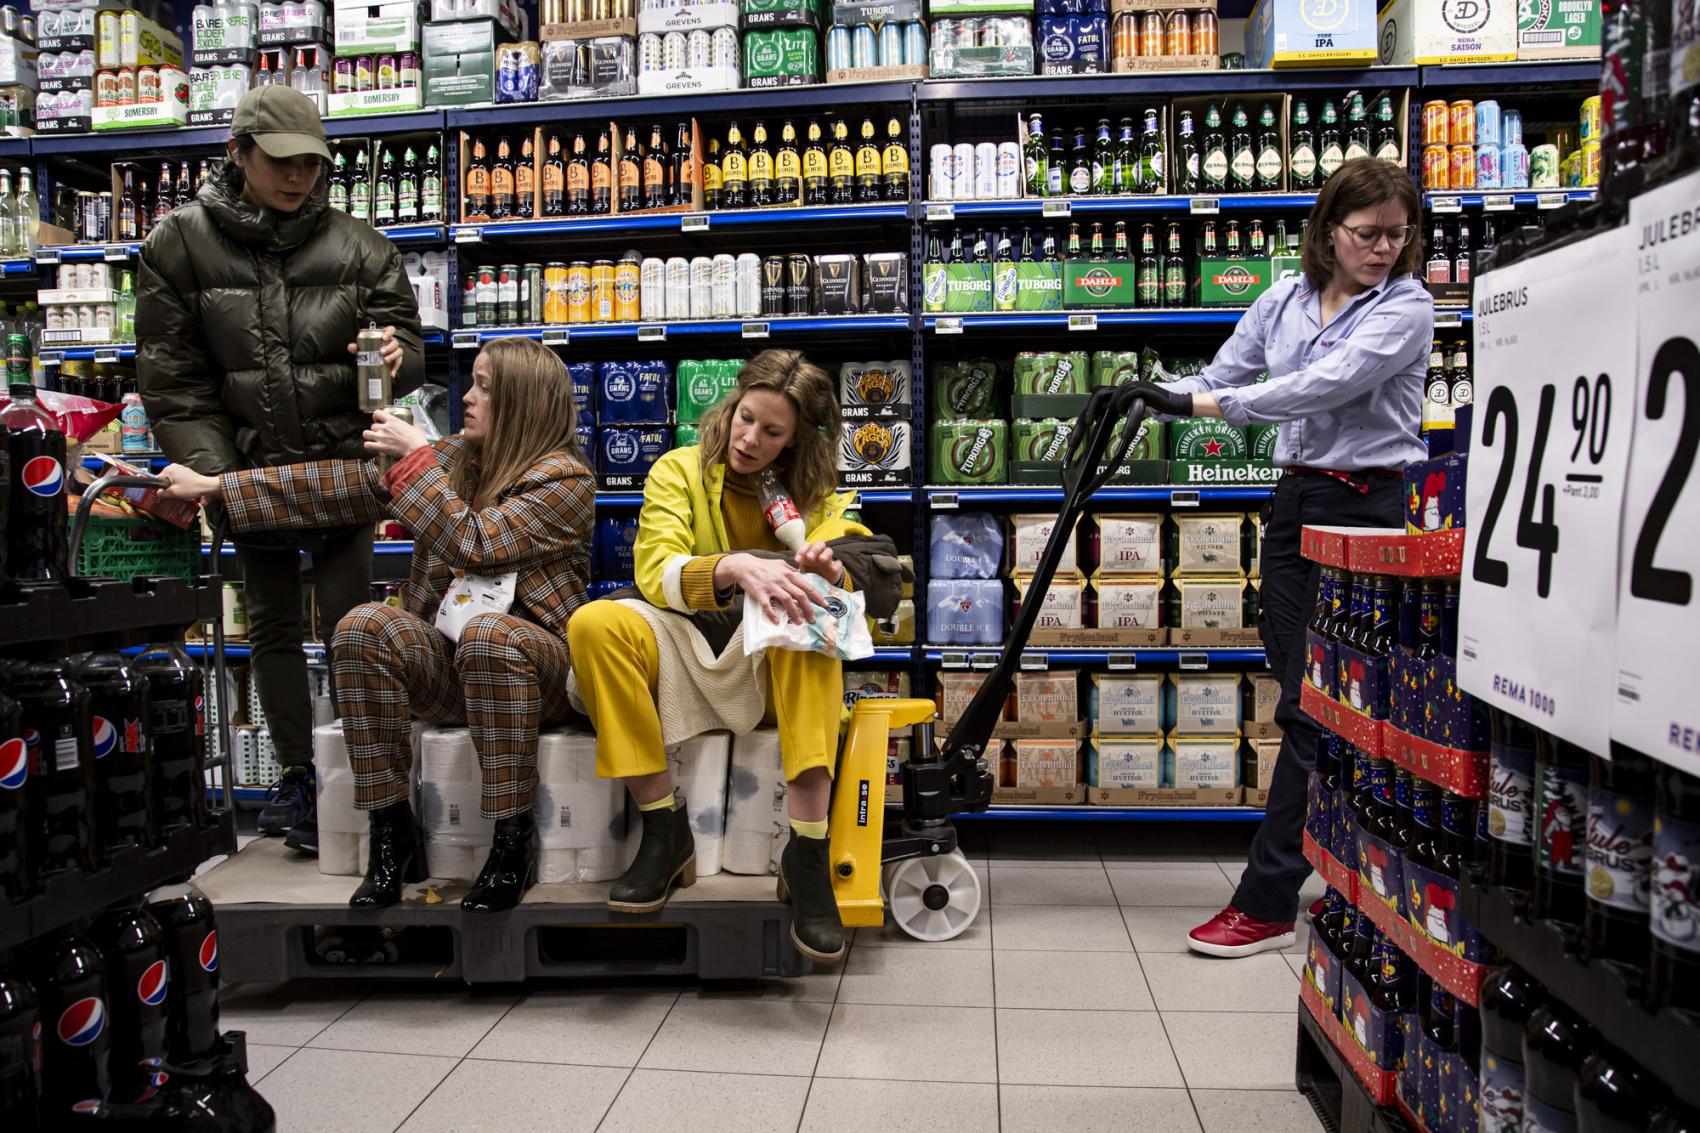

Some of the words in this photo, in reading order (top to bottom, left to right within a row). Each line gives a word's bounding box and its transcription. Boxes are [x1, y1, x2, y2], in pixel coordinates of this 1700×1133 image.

[860, 6, 895, 16] TUBORG
[749, 13, 775, 22] GRANS
[1565, 13, 1586, 23] LAGER
[666, 18, 702, 27] GREVENS
[196, 29, 225, 38] CIDER
[262, 33, 285, 42] GRANS
[39, 39, 61, 48] GRANS
[1315, 39, 1334, 48] IPA
[195, 53, 218, 62] GRANS
[1045, 66, 1072, 75] GRANS
[40, 80, 63, 89] GRANS
[666, 81, 702, 90] GREVENS
[752, 77, 778, 86] GRANS
[364, 94, 400, 104] SOMERSBY
[124, 107, 158, 118] SOMERSBY
[191, 113, 213, 122] GRANS
[38, 120, 59, 130] GRANS
[947, 280, 991, 291] TUBORG
[1018, 279, 1062, 290] TUBORG
[1081, 278, 1117, 286] DAHLS
[927, 277, 945, 301] TUBORG
[997, 275, 1014, 300] TUBORG
[1478, 287, 1528, 317] JULEBRUS
[721, 377, 740, 386] LIT
[609, 384, 630, 393] GRANS
[694, 387, 713, 396] GRANS
[842, 408, 869, 416] GRANS
[611, 447, 632, 455] GRANS
[961, 437, 985, 474] TUBORG
[1188, 464, 1283, 482] Heineken
[1631, 336, 1700, 606] 2
[607, 477, 633, 485] GRANS
[846, 474, 872, 482] GRANS
[1473, 383, 1559, 599] 24
[1571, 373, 1612, 465] 90
[1120, 551, 1141, 560] IPA
[1041, 617, 1062, 626] IPA
[1118, 617, 1139, 627] IPA
[1493, 674, 1526, 703] REMA
[1529, 690, 1555, 717] 1000
